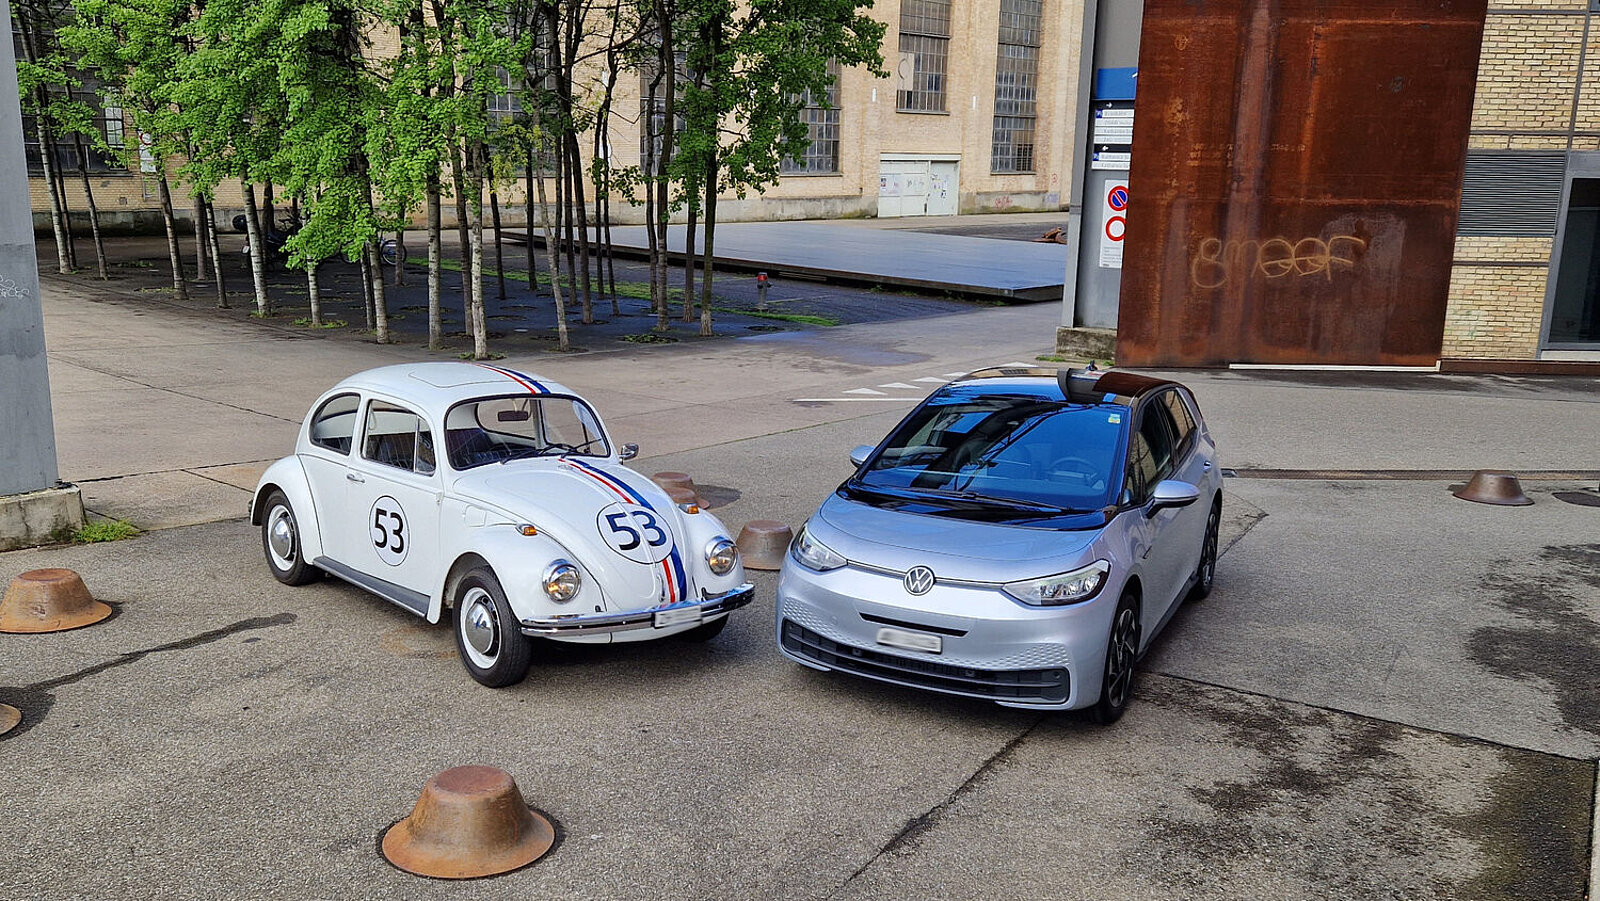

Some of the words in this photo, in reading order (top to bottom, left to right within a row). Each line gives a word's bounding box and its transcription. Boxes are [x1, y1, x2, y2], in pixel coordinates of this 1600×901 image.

[373, 507, 405, 554] 53
[604, 510, 668, 551] 53
[905, 566, 934, 595] VW
